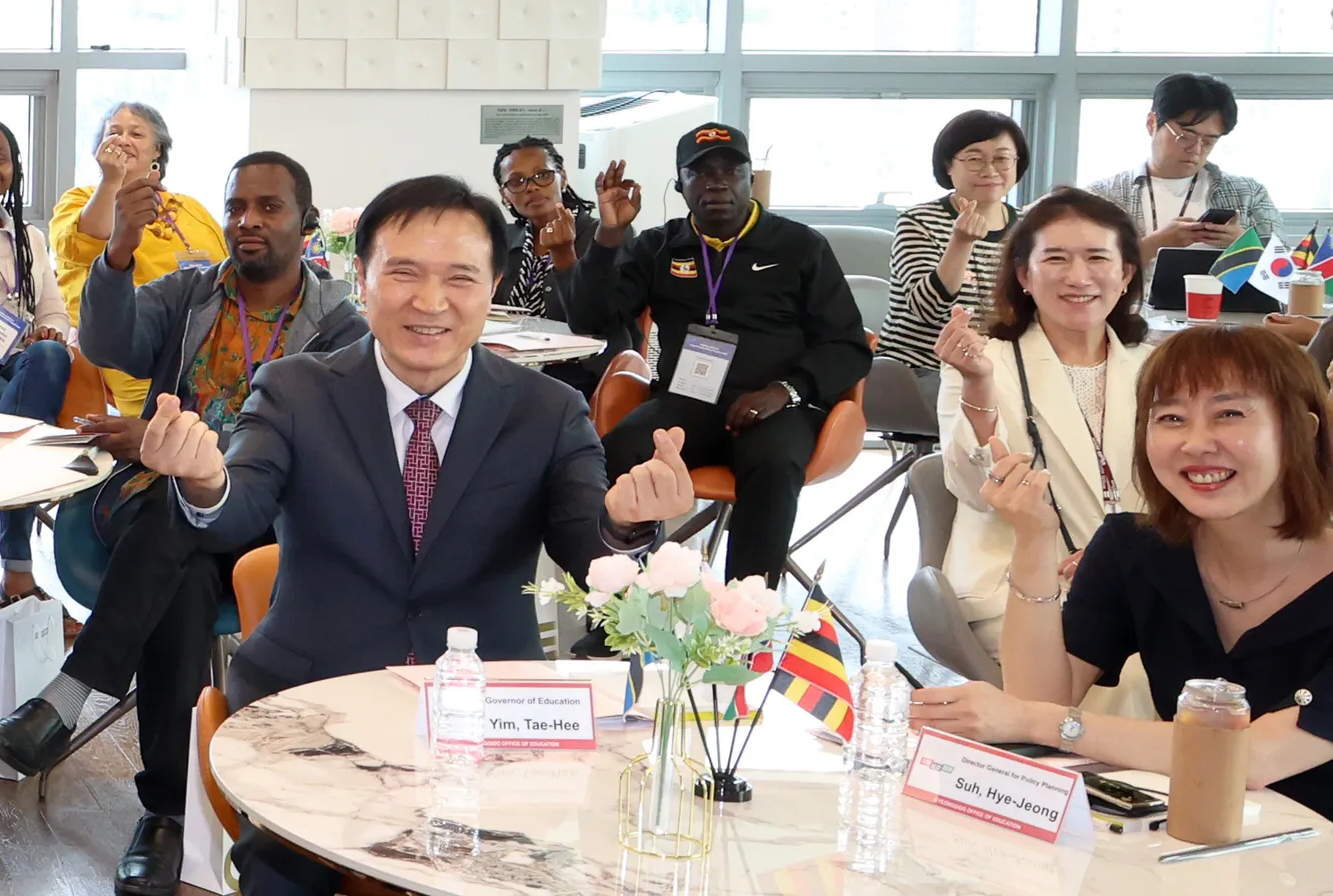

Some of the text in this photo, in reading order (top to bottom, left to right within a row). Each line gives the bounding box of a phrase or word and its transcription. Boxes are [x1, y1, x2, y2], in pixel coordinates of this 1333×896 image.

[485, 696, 580, 706] Governor of Education
[489, 718, 580, 731] Yim, Tae-Hee
[501, 740, 520, 748] OFFICE
[961, 756, 985, 769] Director
[986, 764, 1010, 777] General
[1010, 771, 1020, 780] for
[1020, 774, 1040, 788] Policy
[1041, 781, 1070, 796] Planning
[955, 777, 1059, 823] Suh, Hye-Jeong
[967, 808, 984, 819] OFFICE
[992, 815, 1022, 831] EDUCATION
